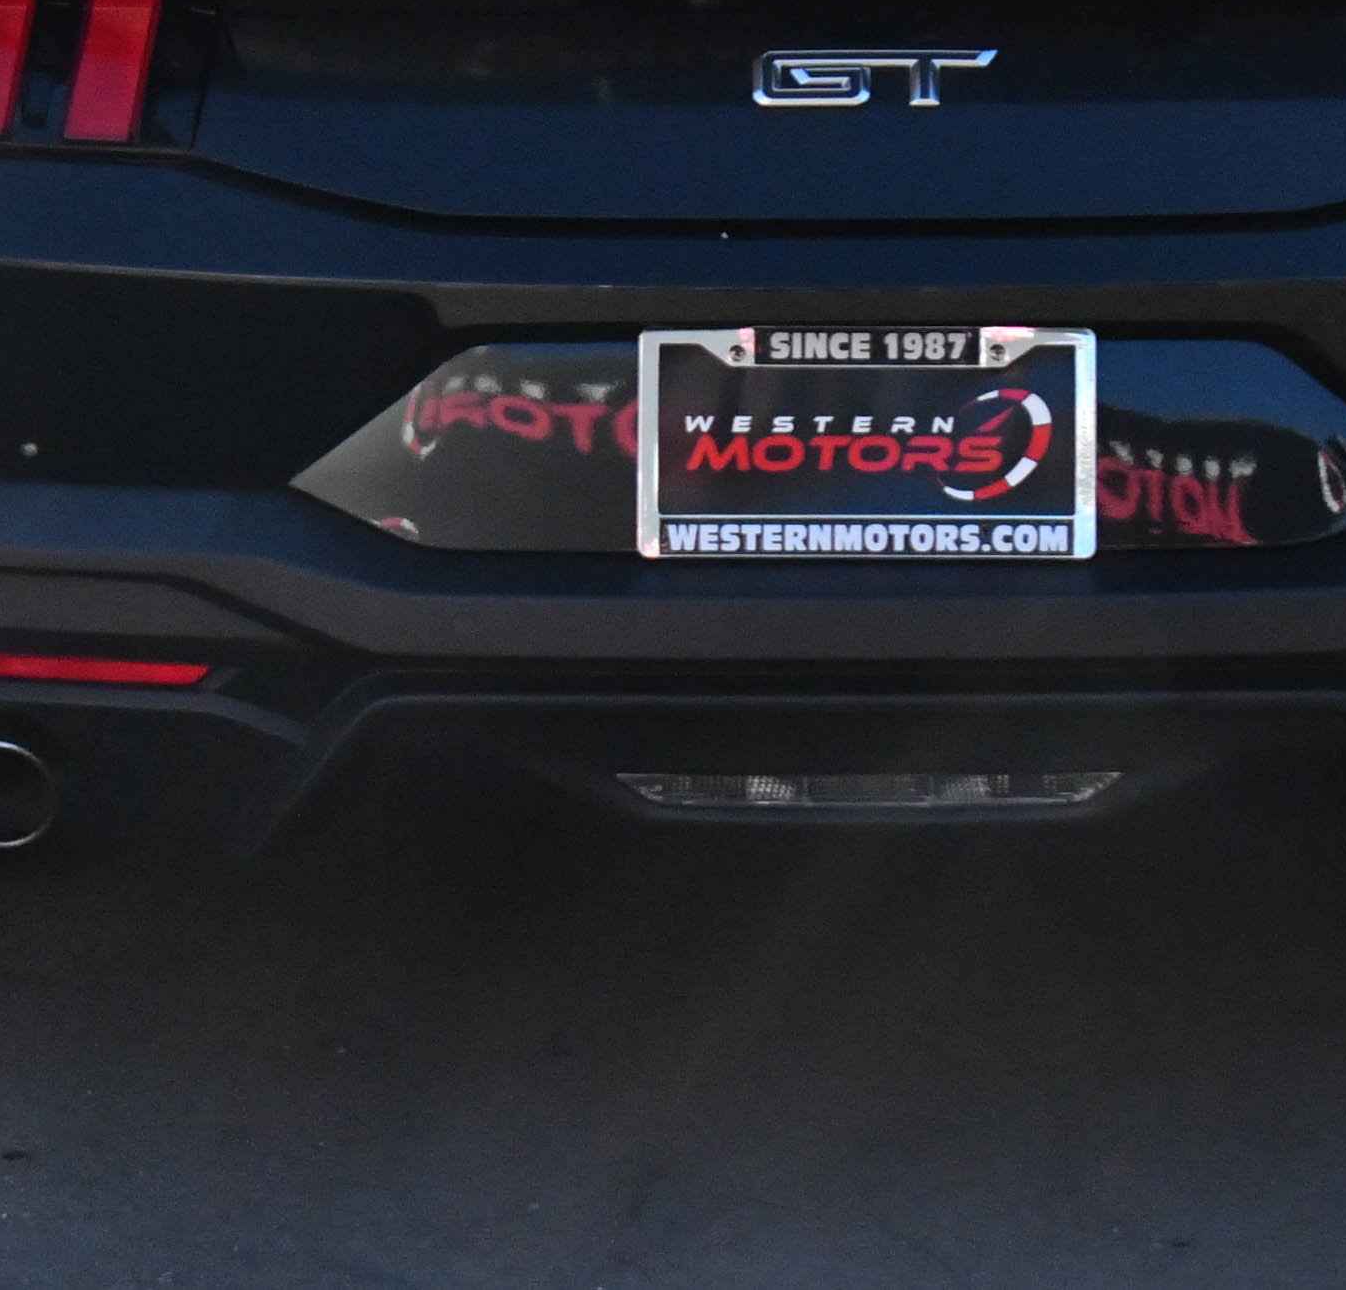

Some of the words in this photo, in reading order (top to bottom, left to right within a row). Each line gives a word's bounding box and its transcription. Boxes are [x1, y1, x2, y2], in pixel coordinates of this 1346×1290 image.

[753, 49, 998, 106] GT
[770, 332, 871, 359] SINCE
[884, 332, 967, 359] 1987
[684, 415, 955, 433] WESTERN
[686, 435, 1004, 472] MOTORS
[667, 523, 1068, 553] WESTERNMOTORS.COM
